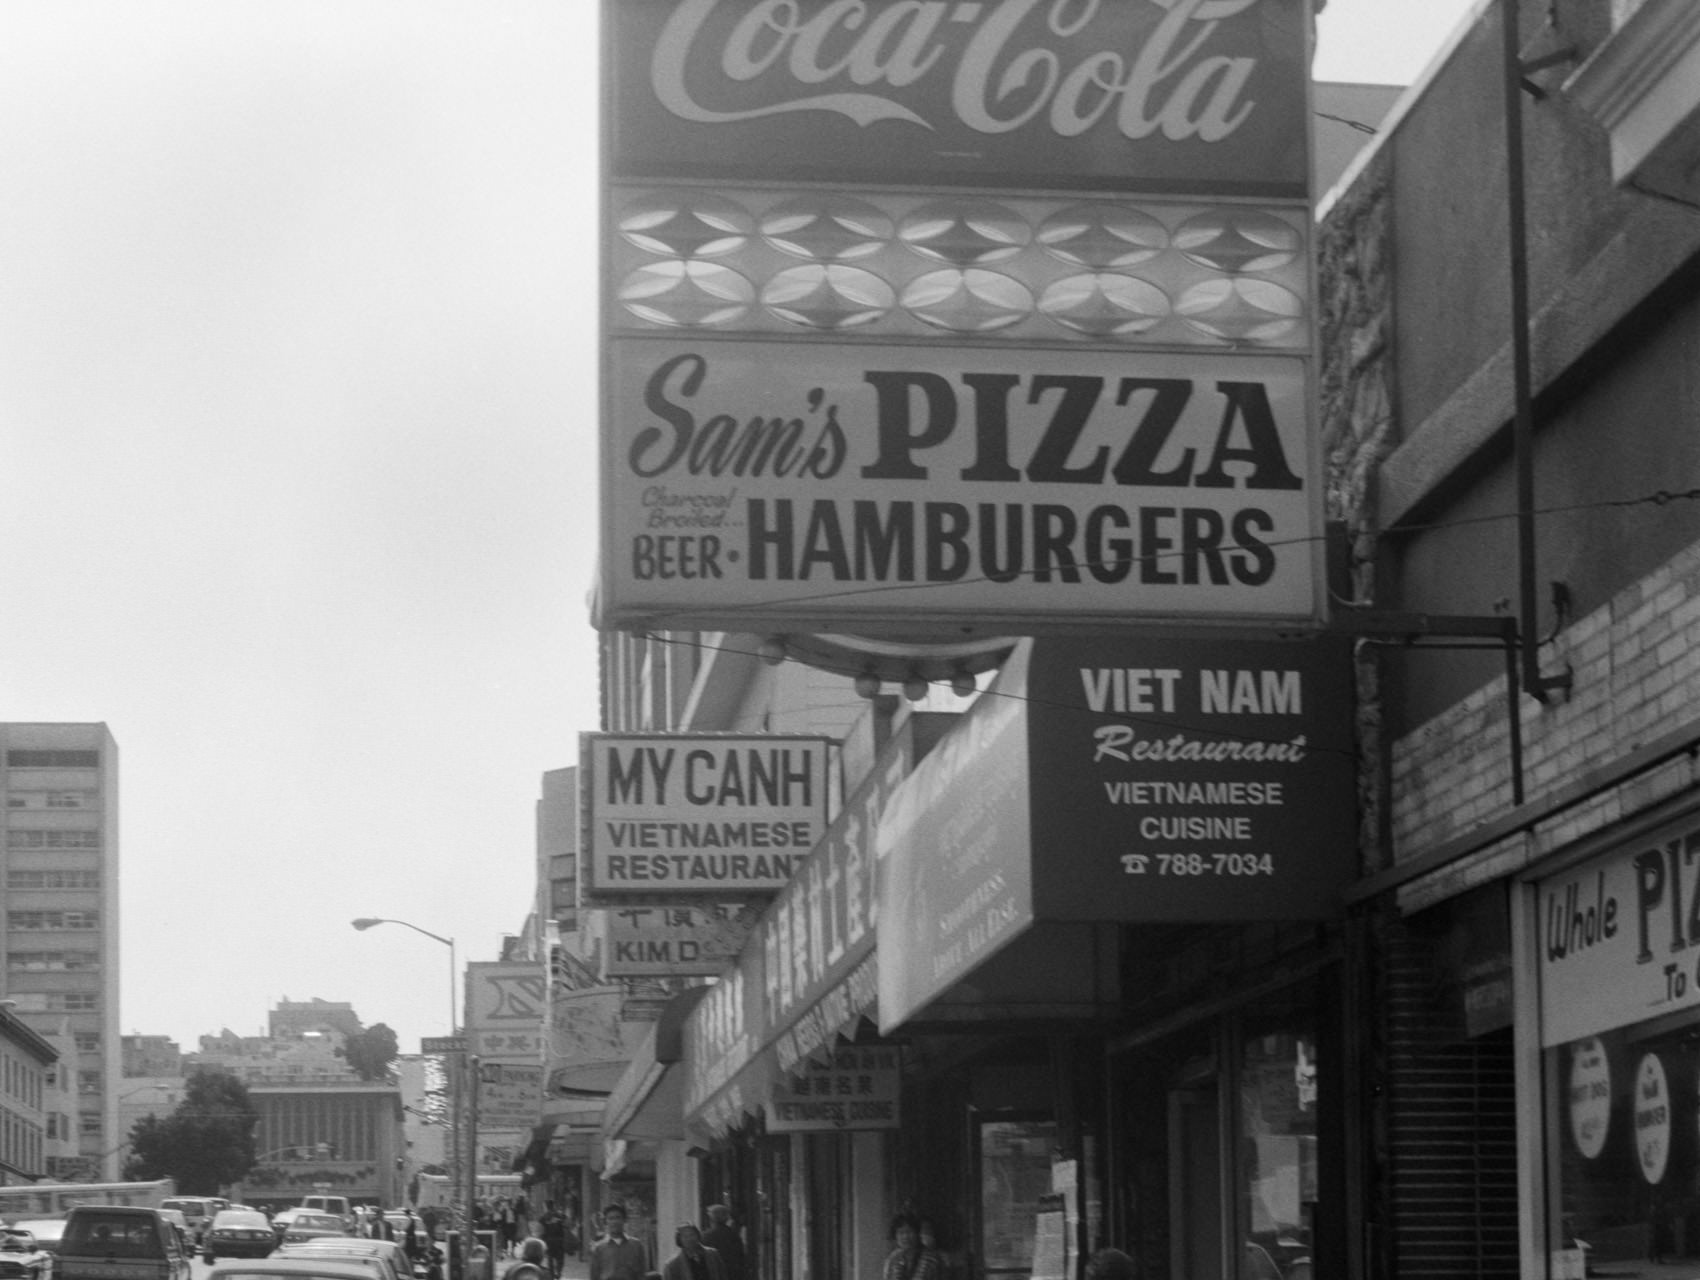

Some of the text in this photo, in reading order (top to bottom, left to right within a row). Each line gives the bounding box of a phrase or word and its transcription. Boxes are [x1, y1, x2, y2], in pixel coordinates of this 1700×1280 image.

[651, 0, 1257, 143] Coca-Cola
[629, 352, 1304, 491] Sam's PIZZA
[632, 498, 1277, 588] BEER HAMBURGERS
[1080, 668, 1303, 714] VIET NAM
[1093, 724, 1307, 762] Restaurant
[607, 746, 812, 807] MY CANH
[1104, 782, 1284, 806] VIETNAMESE
[606, 821, 812, 849] VIETNAMESE
[1140, 816, 1252, 840] CUISINE
[608, 854, 801, 881] RESTAURAN
[1156, 853, 1274, 876] 788-7034
[1548, 871, 1618, 963] Whole
[616, 940, 671, 963] KIM
